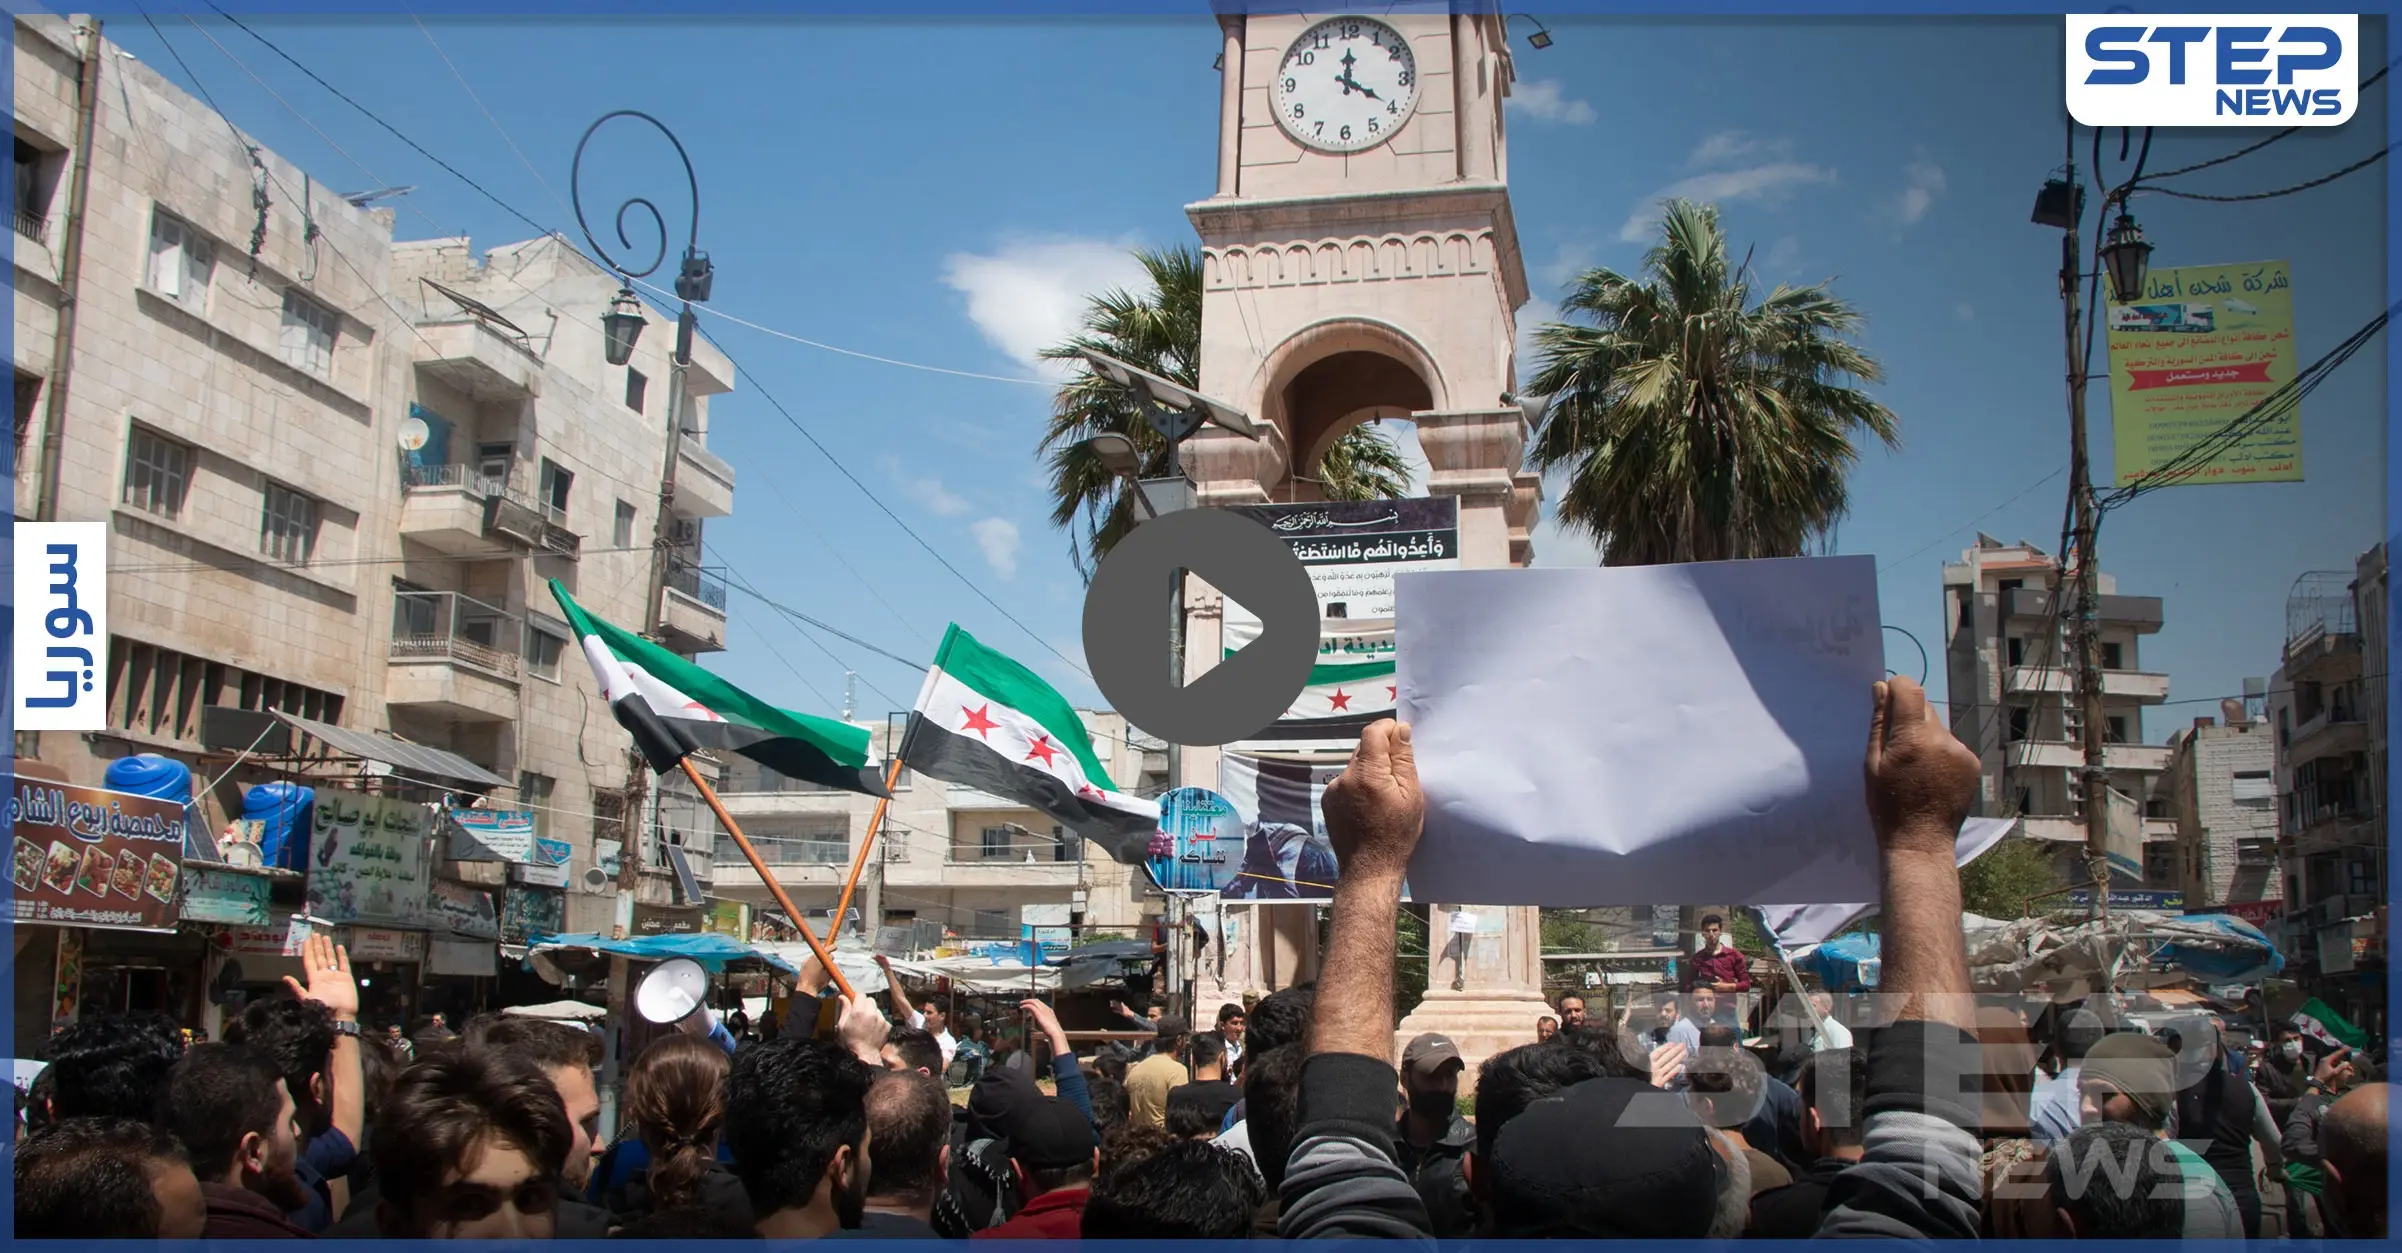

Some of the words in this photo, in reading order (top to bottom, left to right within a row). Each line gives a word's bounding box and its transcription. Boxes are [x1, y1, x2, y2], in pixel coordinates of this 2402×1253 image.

[1339, 25, 1360, 40] 12
[1373, 31, 1381, 46] 1
[1313, 33, 1330, 49] 11
[1296, 51, 1315, 66] 10
[1389, 46, 1401, 62] 2
[1285, 78, 1296, 93] 9
[1398, 71, 1409, 86] 3
[1294, 103, 1304, 118] 8
[1387, 99, 1397, 114] 4
[1314, 121, 1324, 136] 7
[1368, 117, 1379, 132] 5
[1340, 125, 1352, 140] 6
[2189, 275, 2231, 296] شحن
[2241, 269, 2289, 295] شركة
[2165, 370, 2210, 383] ومستعمل
[2212, 370, 2240, 380] جديد
[1344, 637, 1395, 659] دينة
[111, 800, 184, 843] محمصة
[1190, 826, 1217, 844] لن
